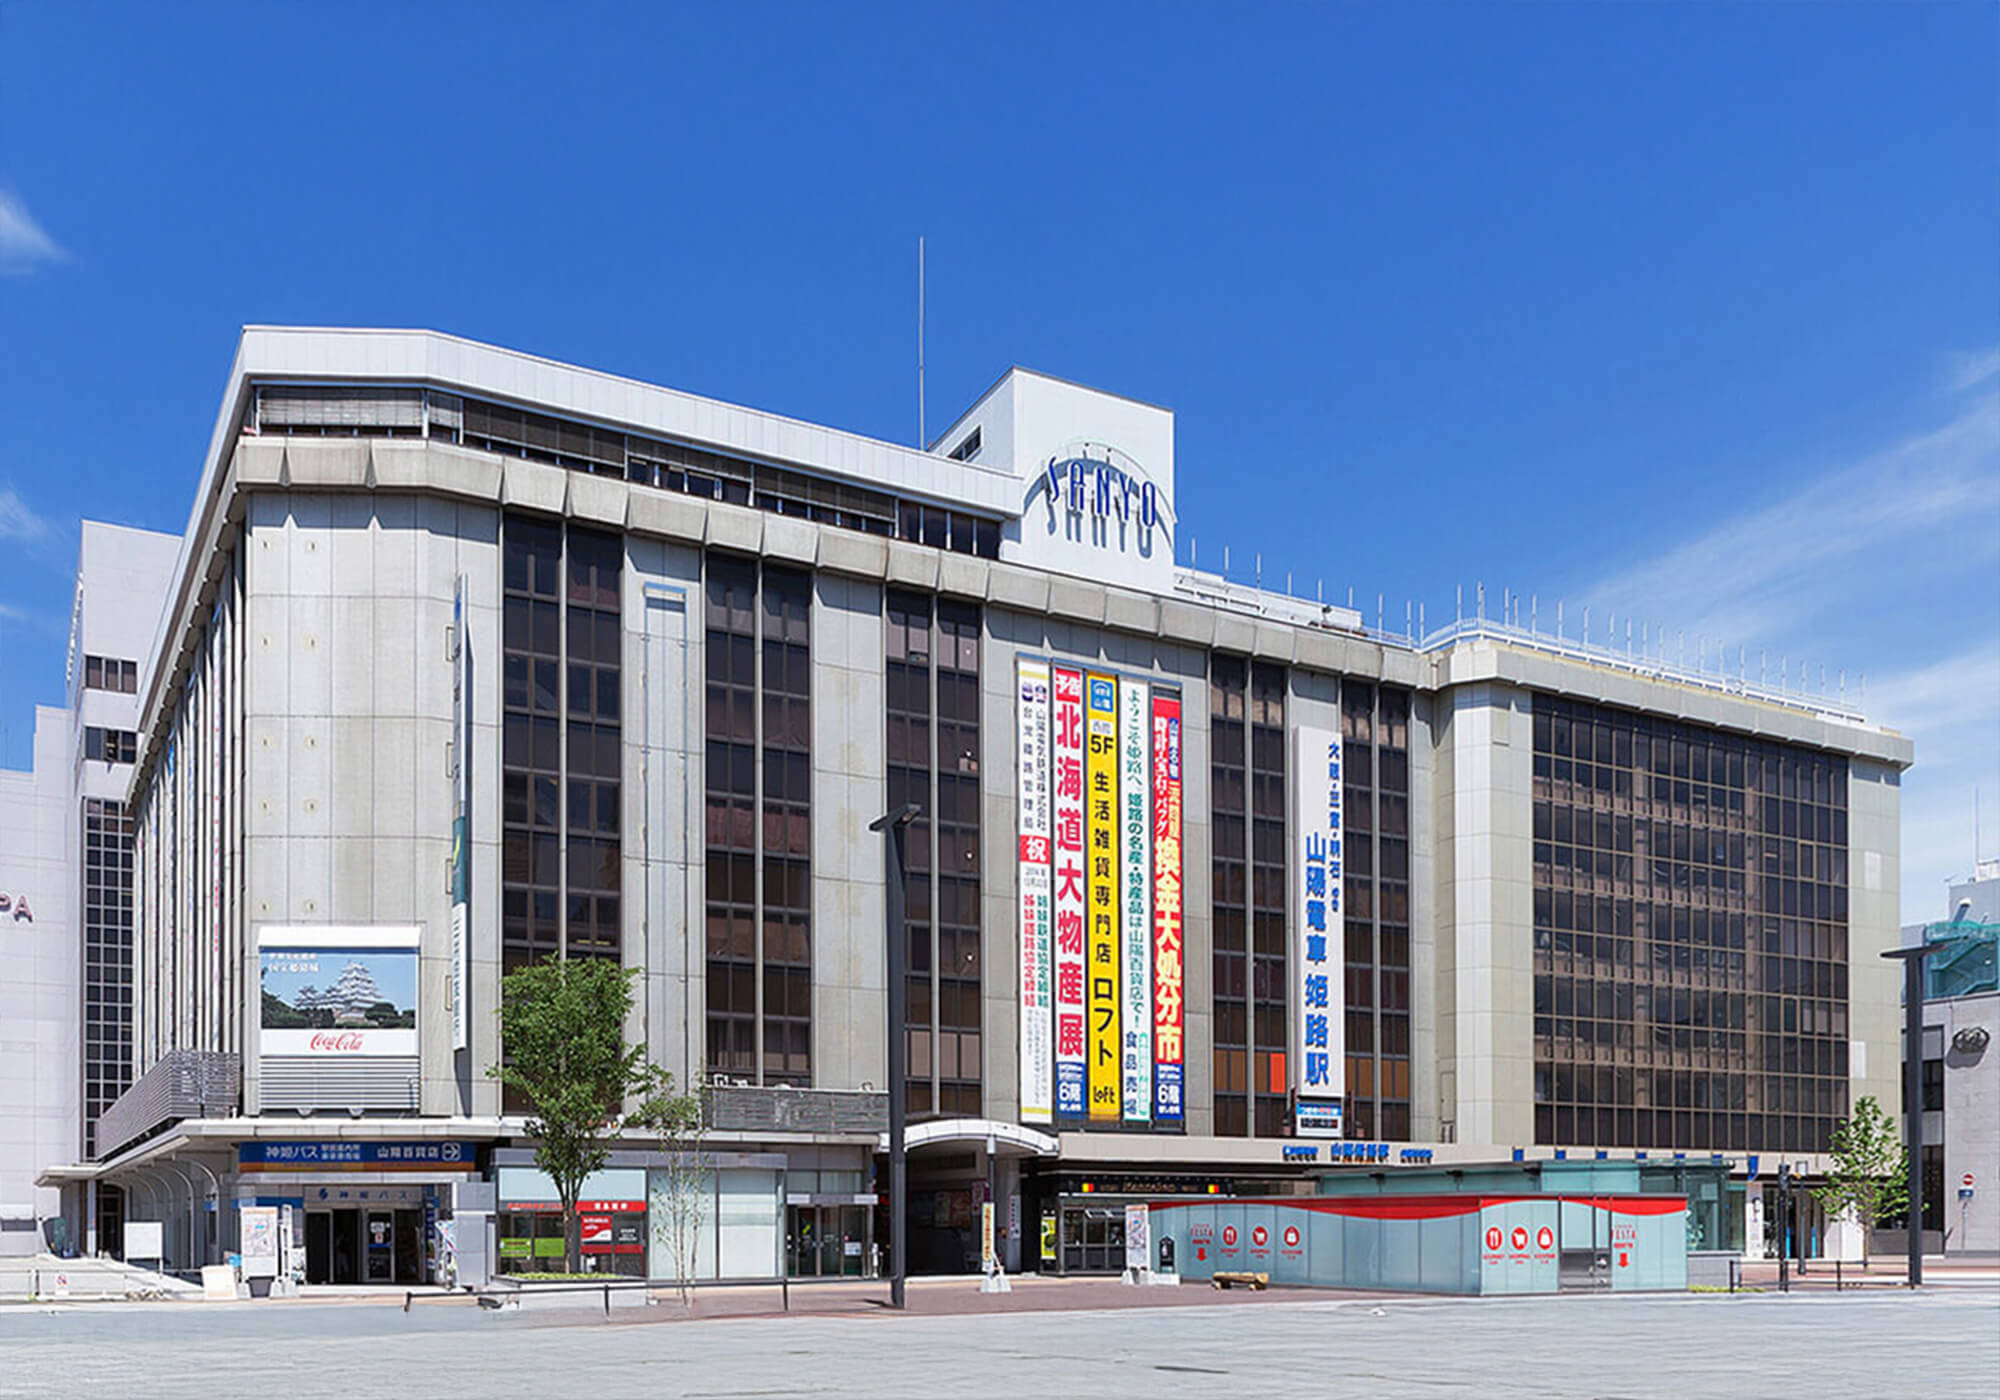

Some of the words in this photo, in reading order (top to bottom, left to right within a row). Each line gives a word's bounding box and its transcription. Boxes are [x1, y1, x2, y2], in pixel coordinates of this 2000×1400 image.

[1047, 456, 1156, 528] SANYO
[1090, 734, 1114, 755] 5F
[1026, 836, 1047, 861] 祝
[1056, 704, 1083, 1056] 北海道大物産展
[1094, 771, 1112, 963] 生活雑貨専門店
[1305, 831, 1328, 966] 山陽電車
[1093, 978, 1113, 1067] ロフト
[1305, 973, 1330, 1086] 姫路駅
[377, 1146, 439, 1159] 山陽百貨店
